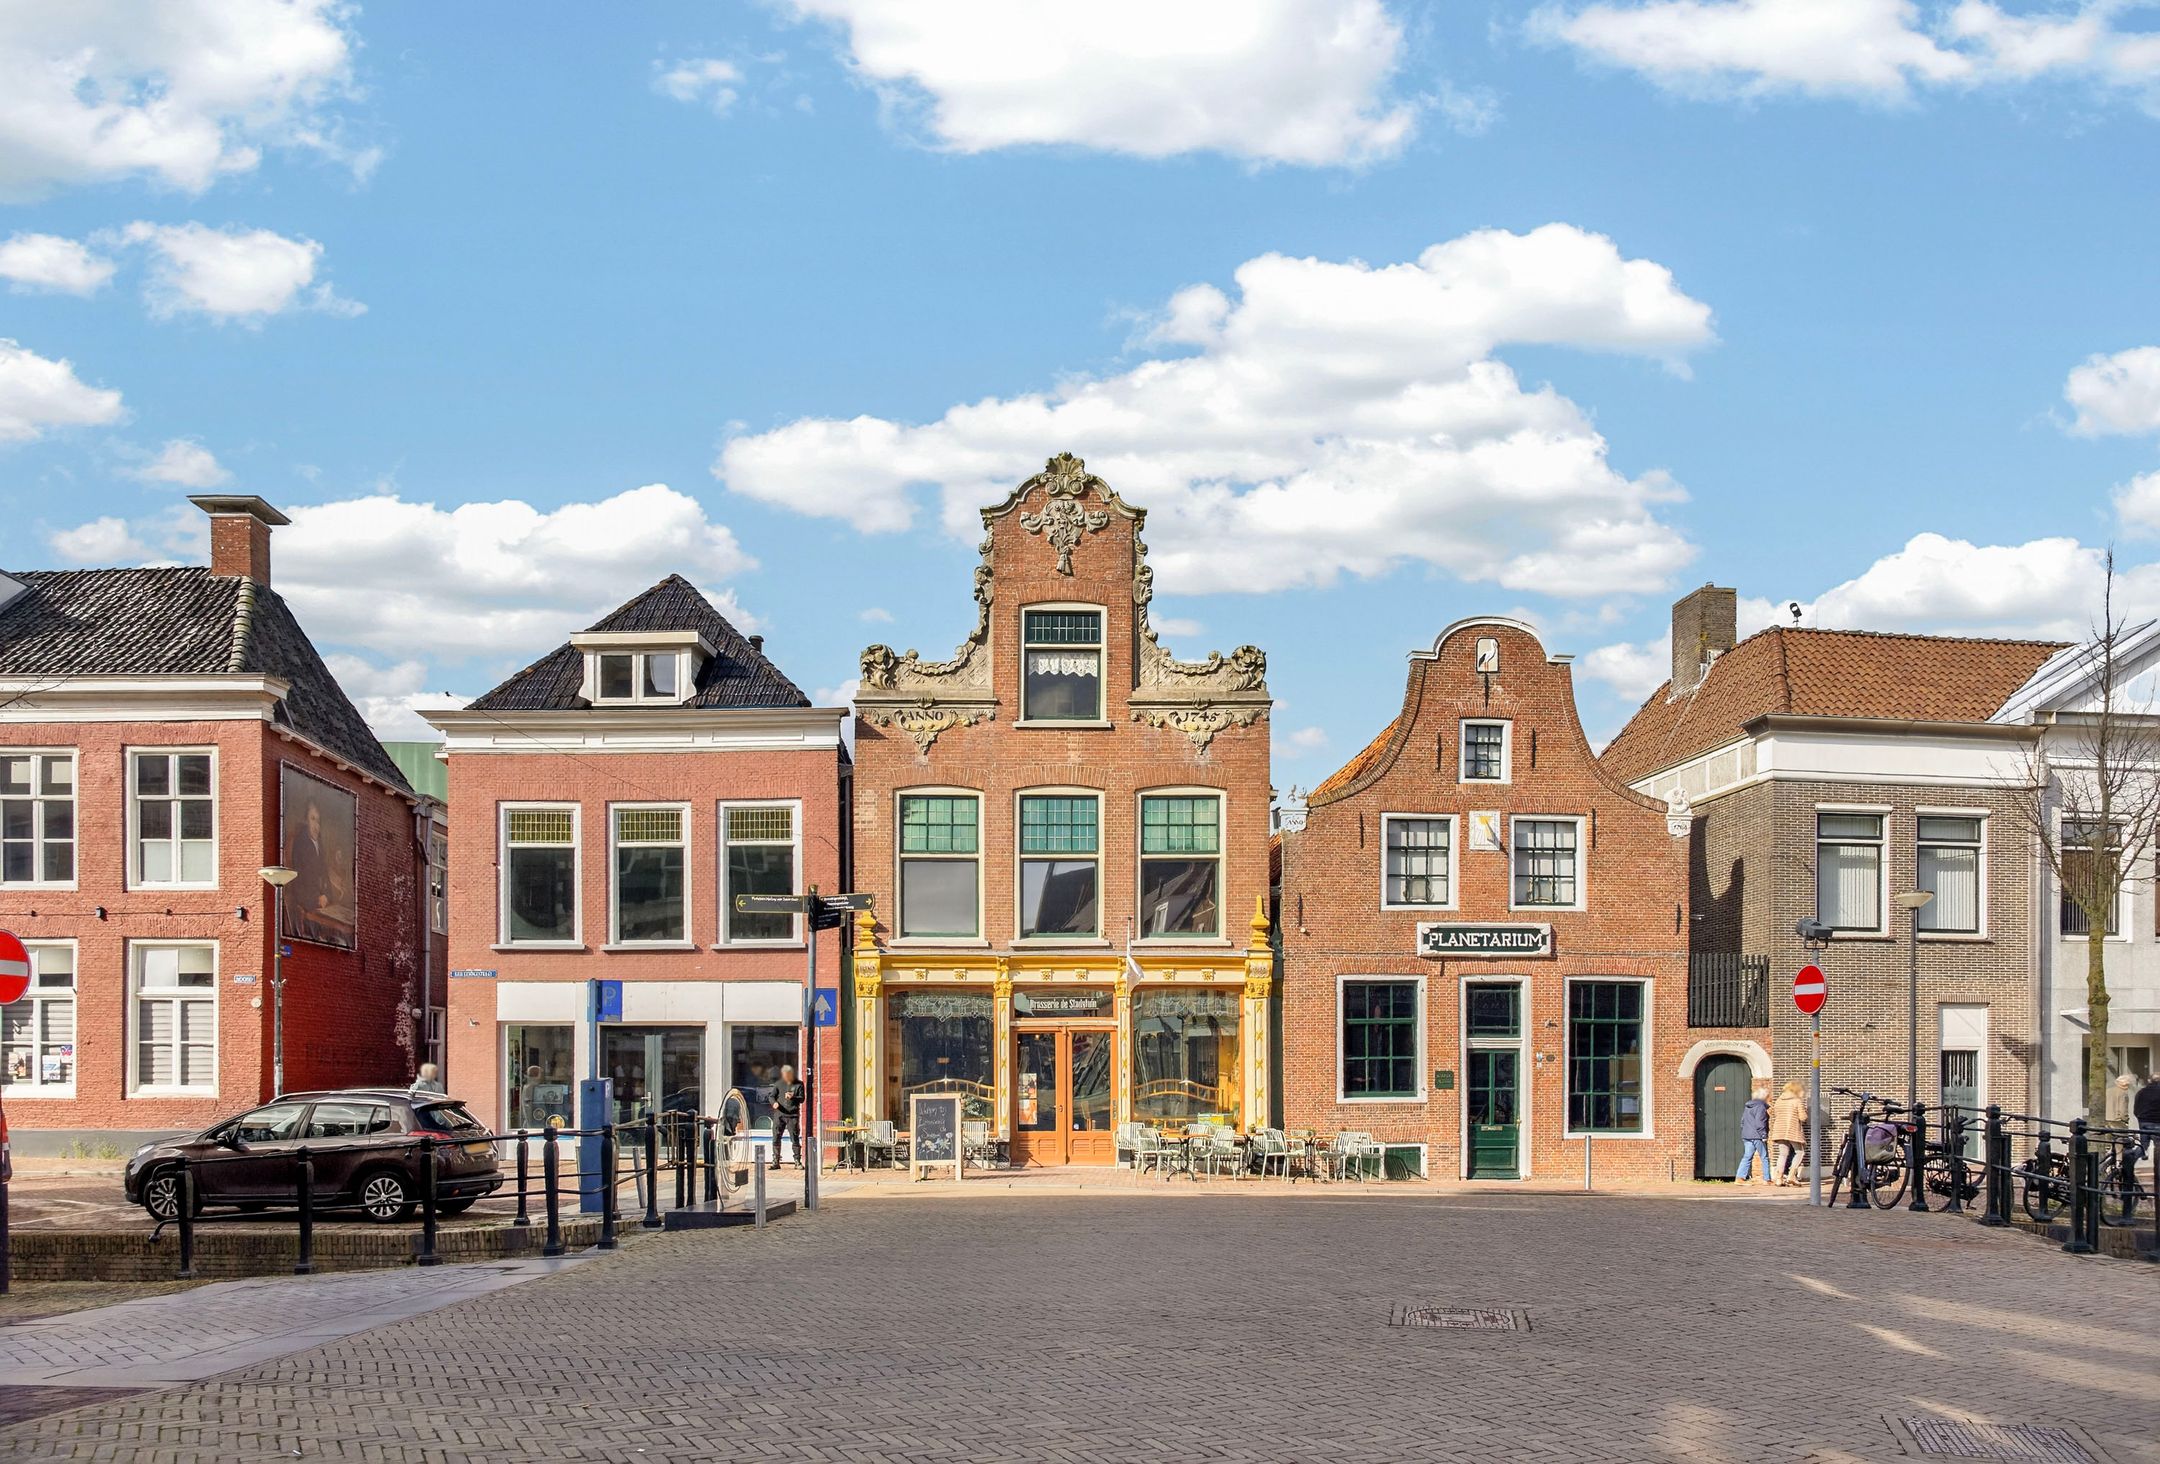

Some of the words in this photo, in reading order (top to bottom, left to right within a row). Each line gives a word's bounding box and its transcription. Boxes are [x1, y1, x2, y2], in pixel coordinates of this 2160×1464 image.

[906, 711, 944, 721] ANNO
[1181, 711, 1221, 722] 1745
[1429, 932, 1543, 947] PLANETARIUM
